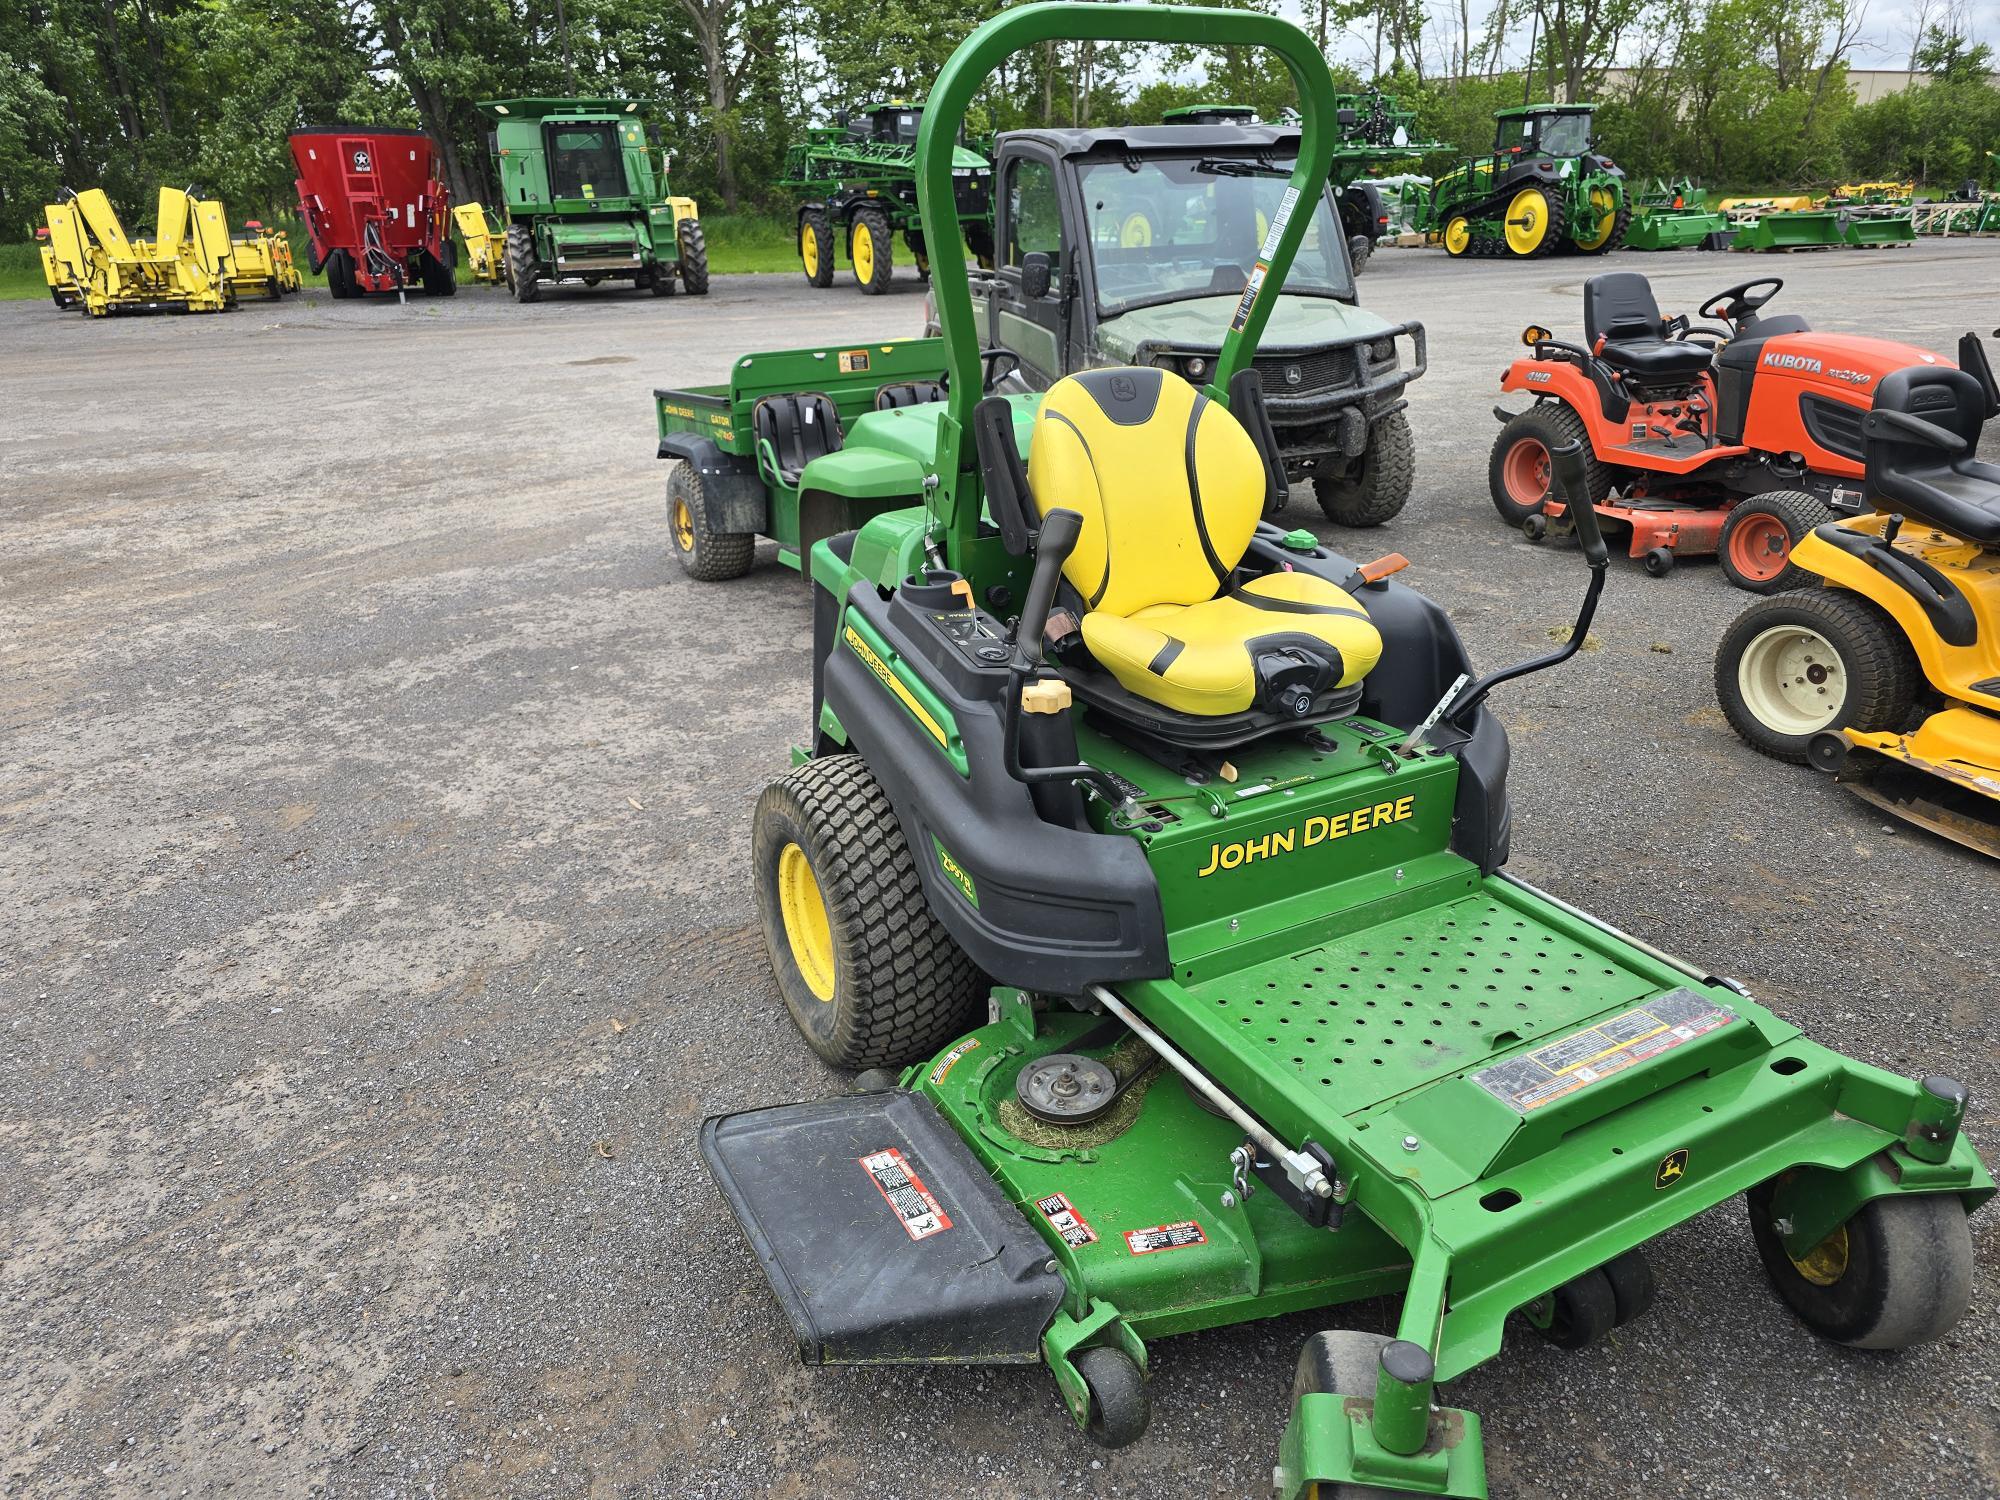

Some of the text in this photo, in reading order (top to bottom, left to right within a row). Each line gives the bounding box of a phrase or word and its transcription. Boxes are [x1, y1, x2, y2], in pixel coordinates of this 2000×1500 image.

[1763, 352, 1822, 374] KUBOTA
[664, 404, 695, 419] JOHN DEERE
[710, 414, 731, 427] GATOR
[849, 634, 892, 686] JOHN DEERE
[1198, 795, 1415, 878] JOHN DEERE
[924, 1195, 944, 1218] PELIGRO
[1138, 1222, 1160, 1234] DANGER
